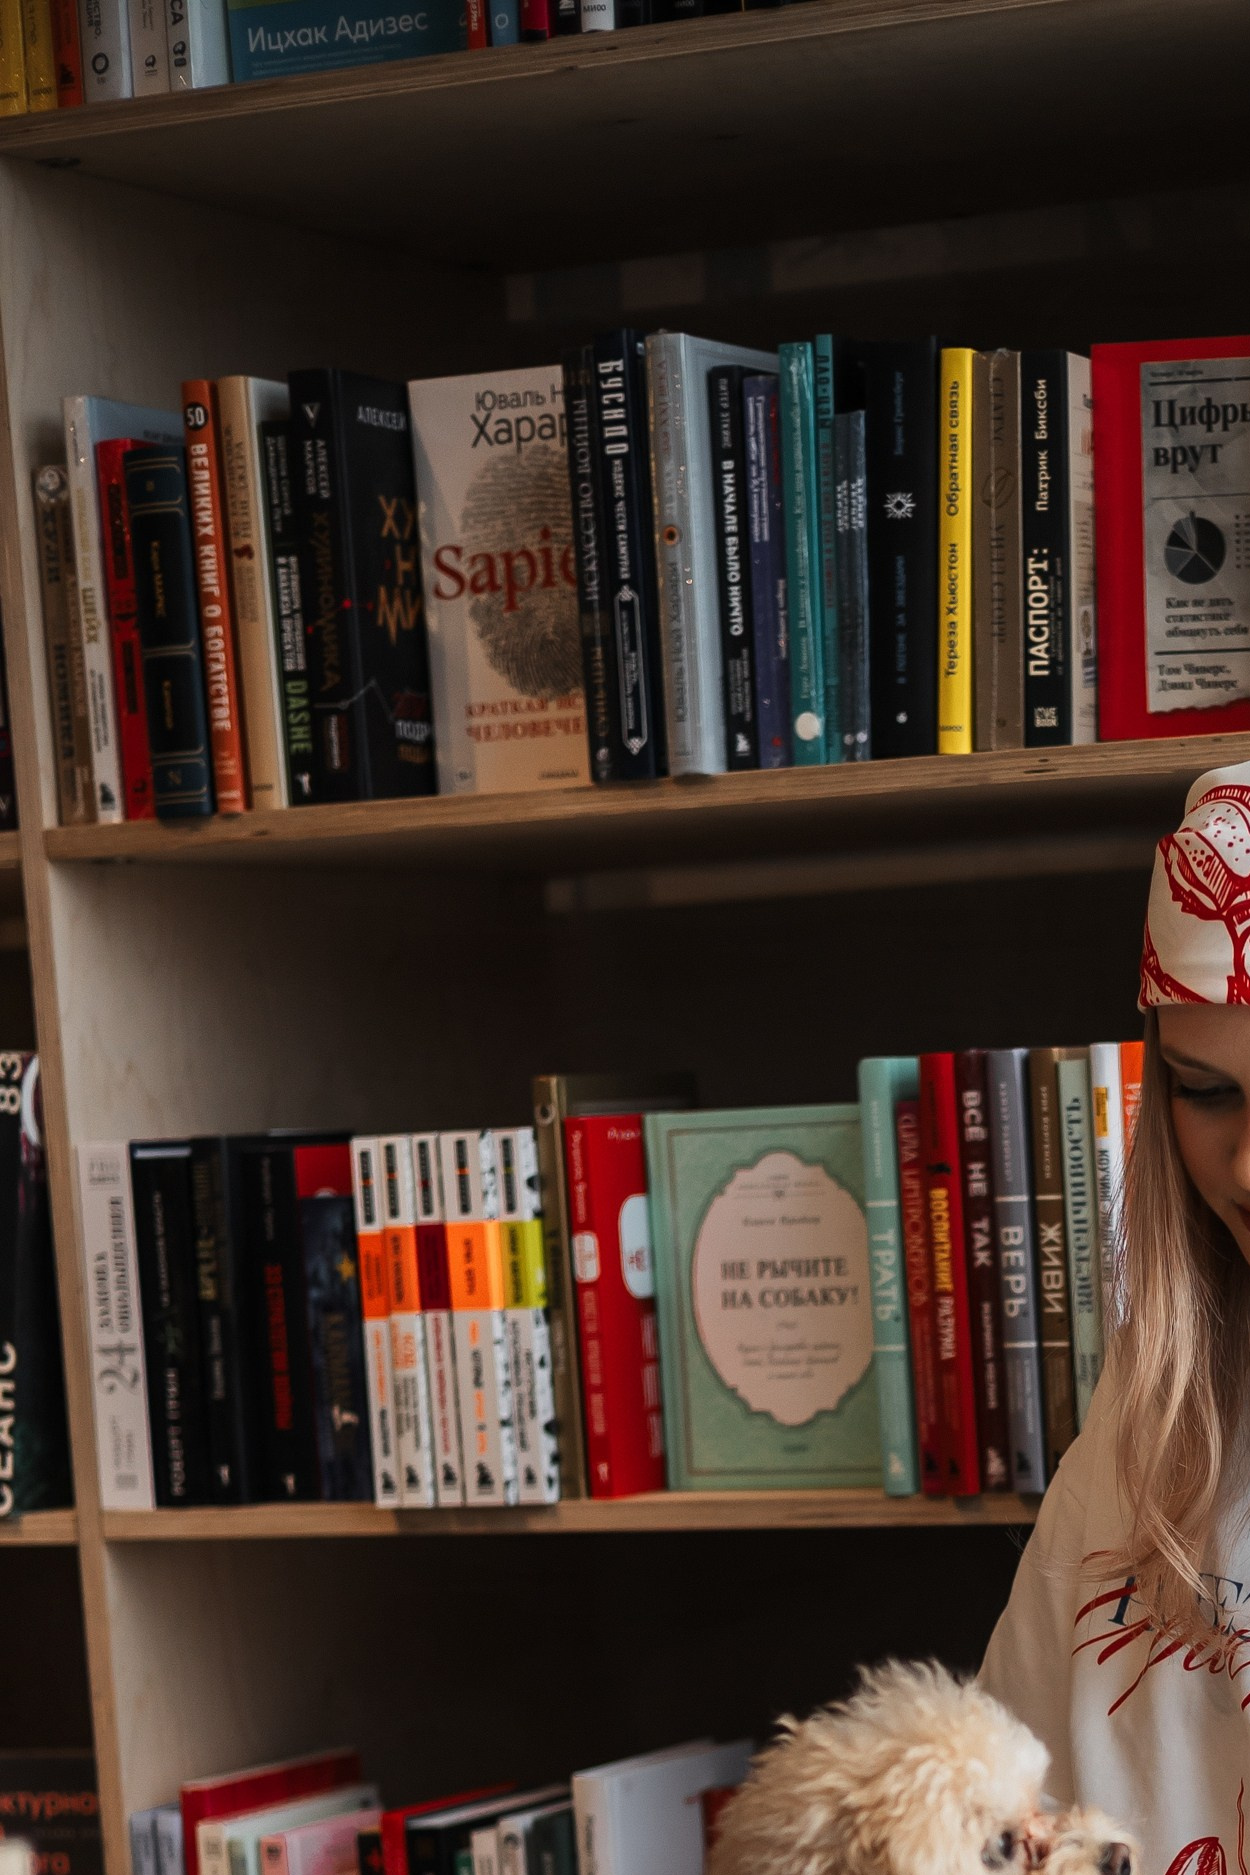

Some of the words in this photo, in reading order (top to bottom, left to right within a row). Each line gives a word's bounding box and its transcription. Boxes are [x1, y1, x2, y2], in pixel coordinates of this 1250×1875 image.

[248, 26, 327, 54] Ицхак
[335, 11, 429, 42] Адизес
[186, 406, 206, 426] 50
[475, 389, 547, 412] Юваль
[597, 358, 630, 456] БУСИДО
[948, 380, 959, 428] связь
[1033, 378, 1049, 440] Биксби
[572, 398, 592, 474] ВОЙНЫ
[1152, 443, 1223, 474] врут
[189, 442, 215, 537] ВЕЛИКИХ
[721, 460, 736, 470] В
[945, 433, 960, 517] Обратная
[1034, 450, 1051, 512] Патрик
[722, 472, 739, 534] НАЧАЛЕ
[578, 483, 600, 601] ИСКУССТВО
[726, 535, 741, 583] БЫЛО
[199, 544, 221, 598] КНИГ
[946, 543, 957, 616] Хьюстон
[202, 604, 222, 618] О
[728, 585, 745, 637] НИЧТО
[1027, 547, 1051, 677] ПАСПОРТ:
[944, 621, 957, 678] Тереза
[204, 625, 232, 732] БОГАТСТВЕ
[961, 1089, 989, 1143] ВСЁ
[966, 1161, 990, 1198] НЕ
[1065, 1097, 1093, 1315] ЗАСТЕНЧИВОСТЬ
[720, 1259, 751, 1281] НЕ
[756, 1255, 849, 1280] РЫЧИТЕ
[928, 1186, 955, 1294] ВОСПИТАНИЕ
[969, 1215, 994, 1270] ТАК
[1038, 1221, 1064, 1314] ЖИВИ
[721, 1288, 754, 1310] НА
[758, 1284, 860, 1310] СОБАКУ!
[871, 1227, 899, 1322] ТРАТЬ
[1000, 1225, 1027, 1319] ВЕРЬ
[95, 1340, 140, 1395] 24
